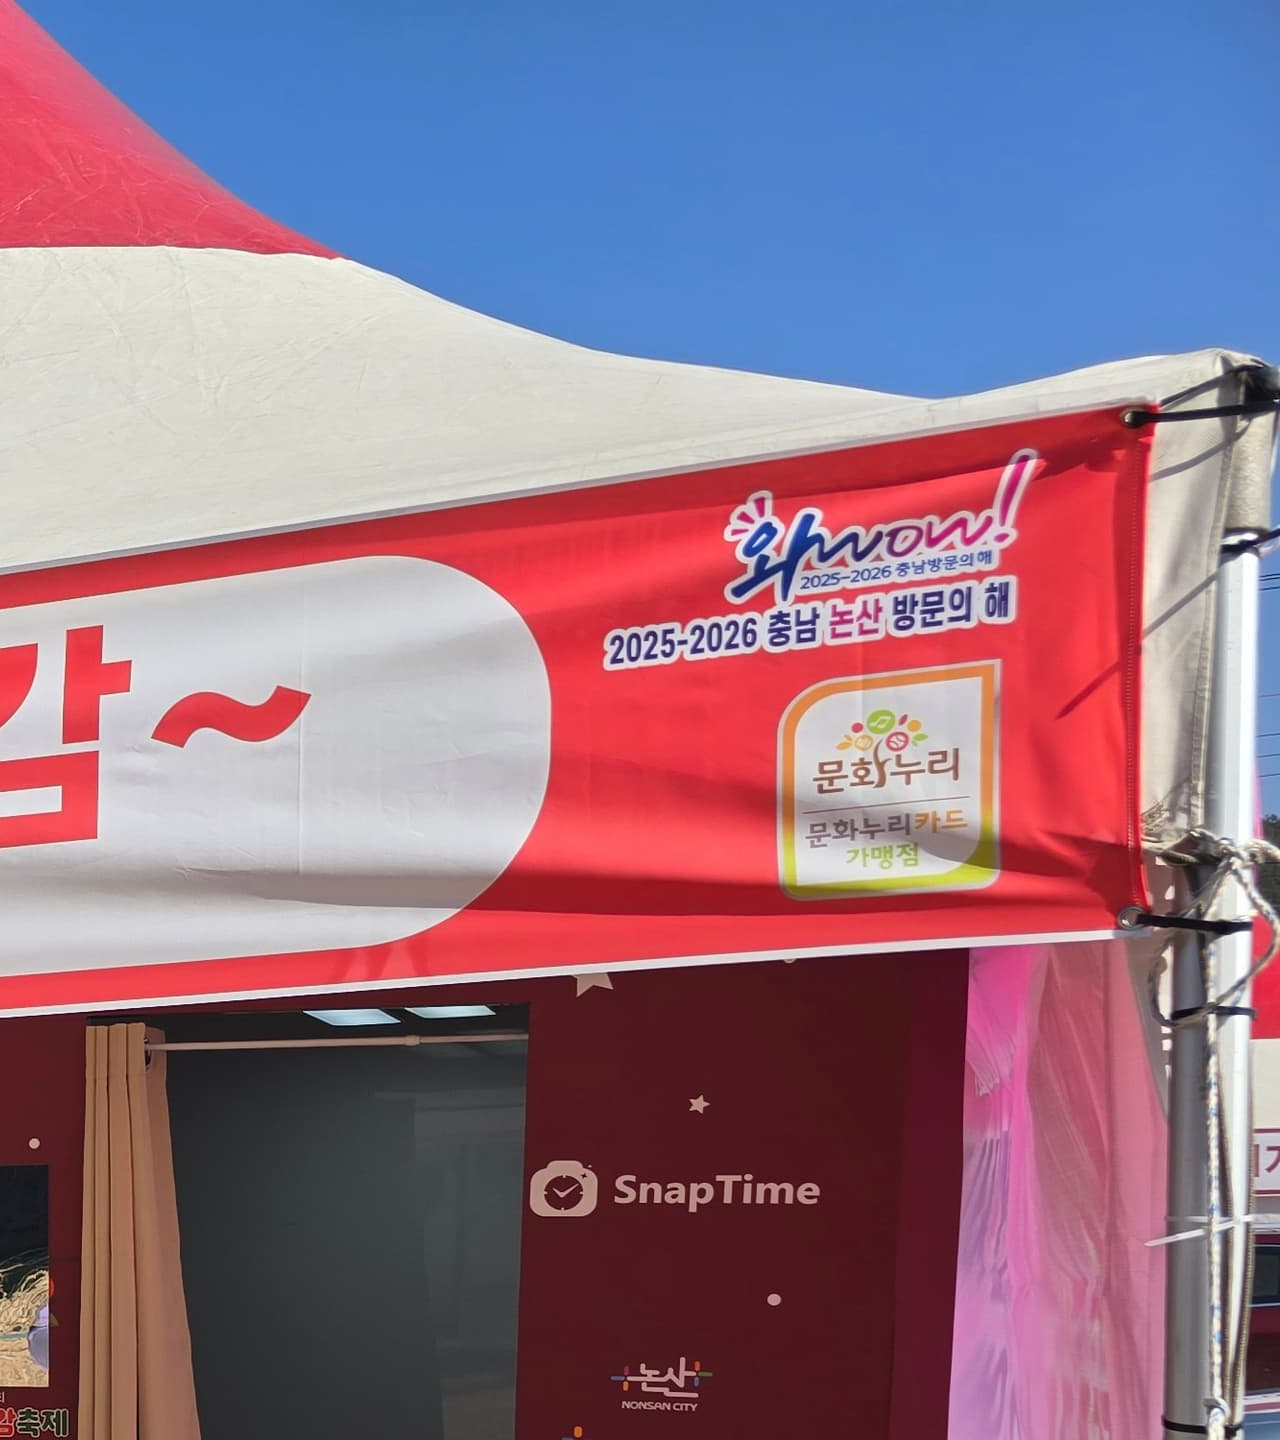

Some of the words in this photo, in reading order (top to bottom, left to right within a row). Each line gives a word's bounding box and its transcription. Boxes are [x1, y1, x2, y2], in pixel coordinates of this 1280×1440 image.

[800, 566, 890, 590] 2025-2026
[608, 618, 758, 665] 2025-2026
[768, 606, 820, 647] 충남
[829, 597, 882, 640] 논산
[892, 586, 972, 631] 방문의
[984, 581, 1010, 619] 해
[813, 746, 959, 794] 문화누리
[805, 809, 968, 848] 문화누리카드
[846, 842, 919, 870] 가맹점
[614, 1174, 820, 1213] SnapTime
[623, 1356, 702, 1398] 논산
[621, 1400, 670, 1411] NONSAN
[672, 1402, 698, 1412] CITY
